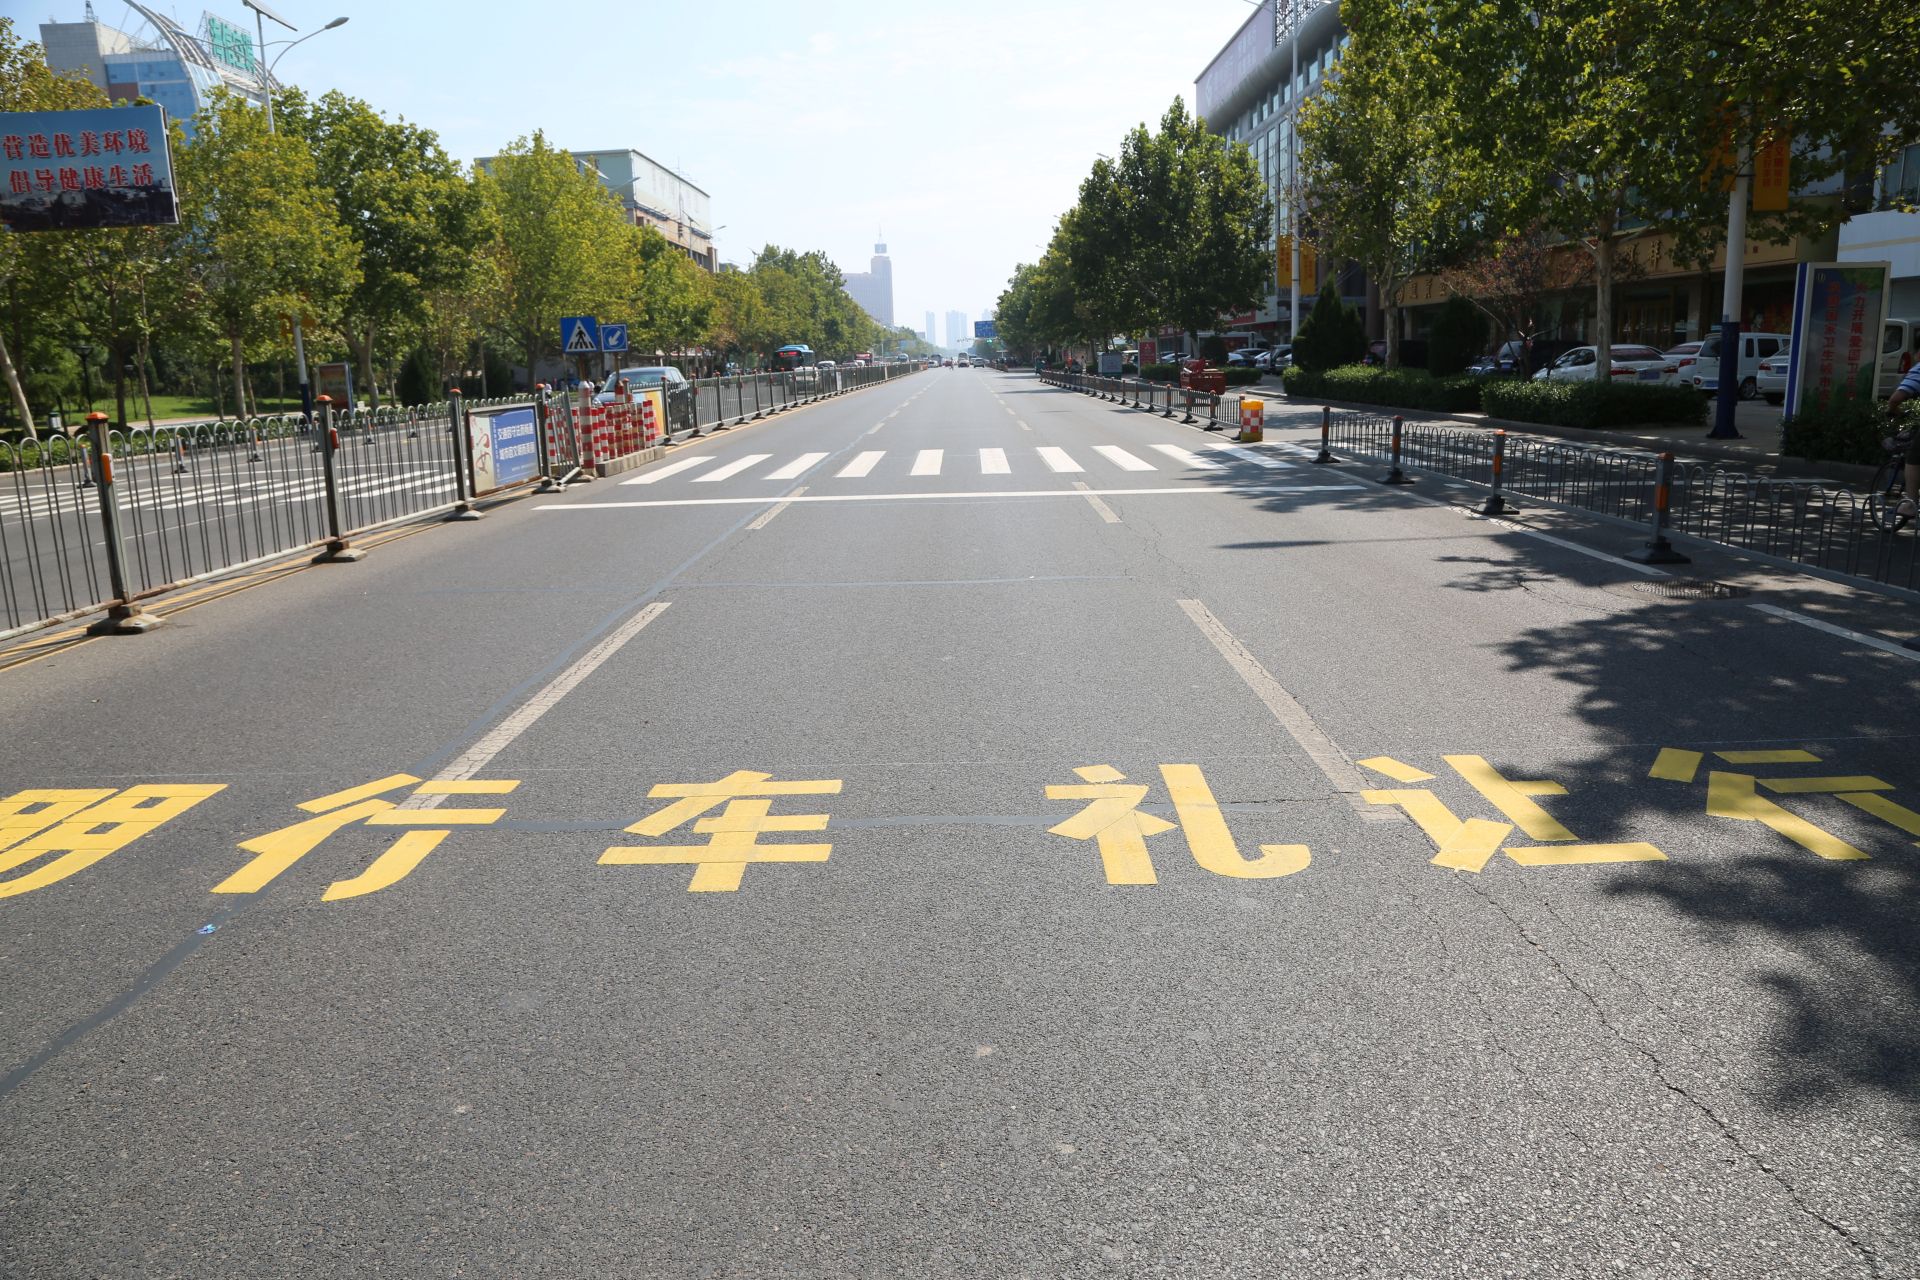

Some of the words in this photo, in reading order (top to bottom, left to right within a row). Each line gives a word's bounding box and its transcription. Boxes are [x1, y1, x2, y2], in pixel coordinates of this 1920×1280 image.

[2, 128, 151, 160] 营造优美环境
[9, 163, 154, 195] 倡导健康生活
